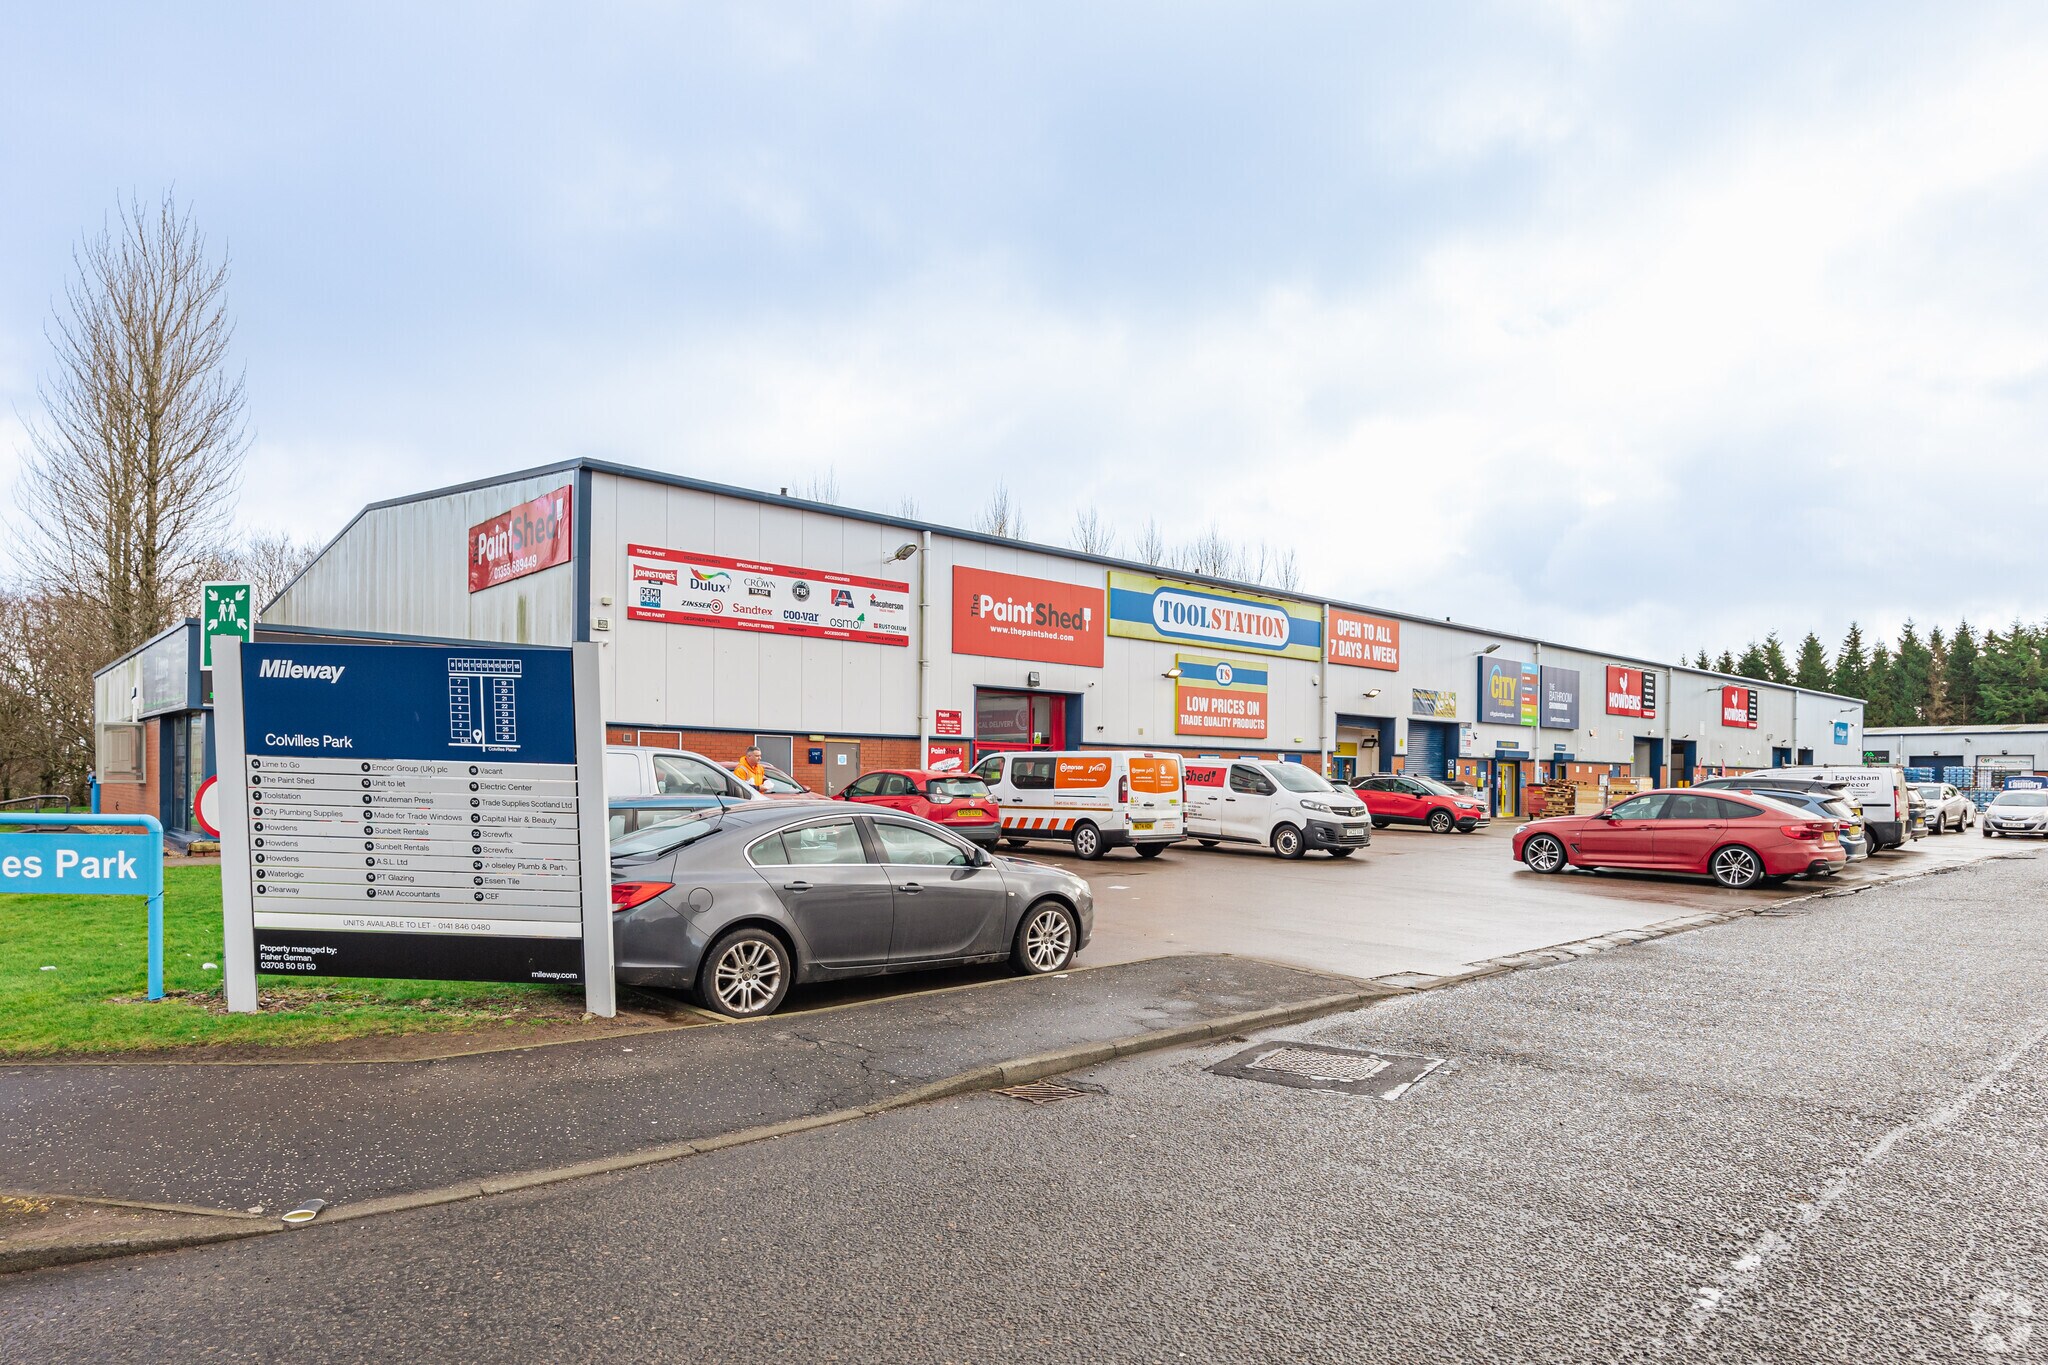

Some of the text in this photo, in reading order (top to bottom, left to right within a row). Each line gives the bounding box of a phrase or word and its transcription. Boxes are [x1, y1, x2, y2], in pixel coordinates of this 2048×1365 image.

[635, 569, 675, 581] JOHNSTONE'S
[690, 578, 726, 593] Dulux
[744, 578, 776, 589] CROWN
[641, 588, 659, 596] DEMI
[641, 595, 661, 603] DEKK
[682, 600, 711, 609] ZINSSER
[733, 603, 773, 616] Sandtex
[870, 600, 904, 610] Macpherson
[971, 594, 979, 616] The
[830, 617, 861, 630] osmo
[1160, 599, 1285, 639] TOOLSTATION
[990, 625, 1074, 641] www.thepaintshed.com
[1337, 619, 1392, 643] OPEN TO ALL
[1331, 639, 1397, 664] 7 DAYS A WEEK
[259, 659, 345, 684] Mileway
[1219, 669, 1231, 681] TS
[1491, 675, 1517, 700] CITY
[1549, 691, 1573, 703] BATHROOM
[1609, 692, 1641, 710] HOWDENS
[1186, 695, 1260, 716] LOW PRICES ON
[1724, 707, 1747, 722] HOWDENS
[989, 720, 1015, 728] DELIVERY
[1180, 714, 1265, 730] TRADE QUALITY PRODUCTS
[265, 733, 353, 748] Colvilles Park
[396, 765, 418, 773] Group
[420, 765, 436, 774] (UK)
[437, 766, 448, 774] plc
[278, 777, 294, 785] Paint
[1185, 770, 1211, 782] Shed
[480, 783, 532, 792] Electric Center
[2009, 780, 2043, 789] Laundry
[373, 796, 413, 804] Minuteman
[502, 800, 530, 808] Supplies
[531, 800, 560, 809] Scotland
[264, 808, 277, 816] City
[279, 808, 311, 818] Plumbing
[314, 810, 343, 819] Supplies
[429, 813, 463, 821] Windows
[482, 815, 507, 824] Capital
[532, 816, 557, 825] Beauty
[375, 827, 429, 836] Sunbelt Rentals
[376, 843, 430, 852] Sunbelt Rentals
[483, 846, 514, 854] Screwfix
[1, 849, 137, 879] es Park
[266, 855, 299, 863] Howdens
[267, 870, 304, 879] Waterlogic
[388, 874, 415, 883] Glazing
[267, 886, 299, 895] Clearway
[396, 890, 440, 898] Accountants
[343, 919, 364, 927] UNITS
[367, 920, 404, 928] AVAILABLE
[260, 944, 337, 955] Property managed by:
[260, 953, 312, 962] Fisher German
[260, 962, 284, 970] 03708
[306, 963, 317, 971] 50
[531, 971, 577, 980] mileway.com
